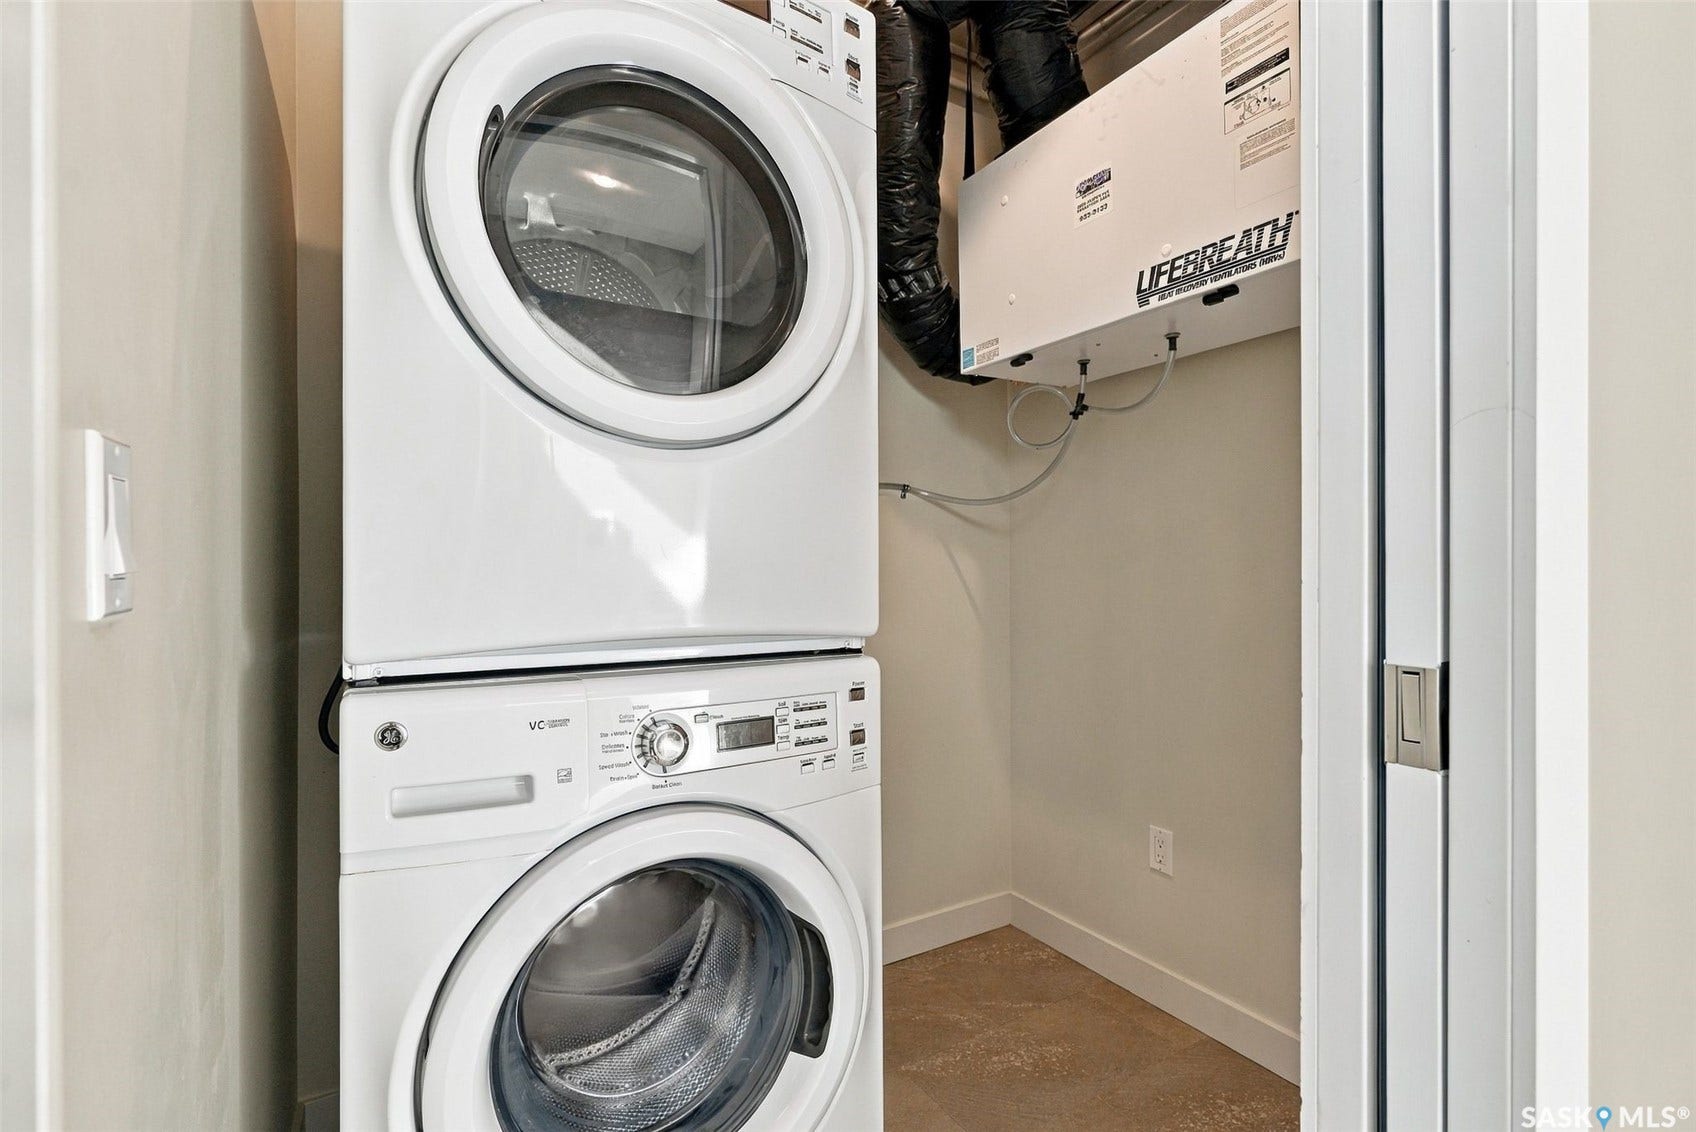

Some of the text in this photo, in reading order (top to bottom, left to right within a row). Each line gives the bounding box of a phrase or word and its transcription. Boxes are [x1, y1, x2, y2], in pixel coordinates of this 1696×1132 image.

[1158, 251, 1286, 302] HEAT RECOVERY VENTILATORS (HRVs)
[529, 720, 545, 731] VC
